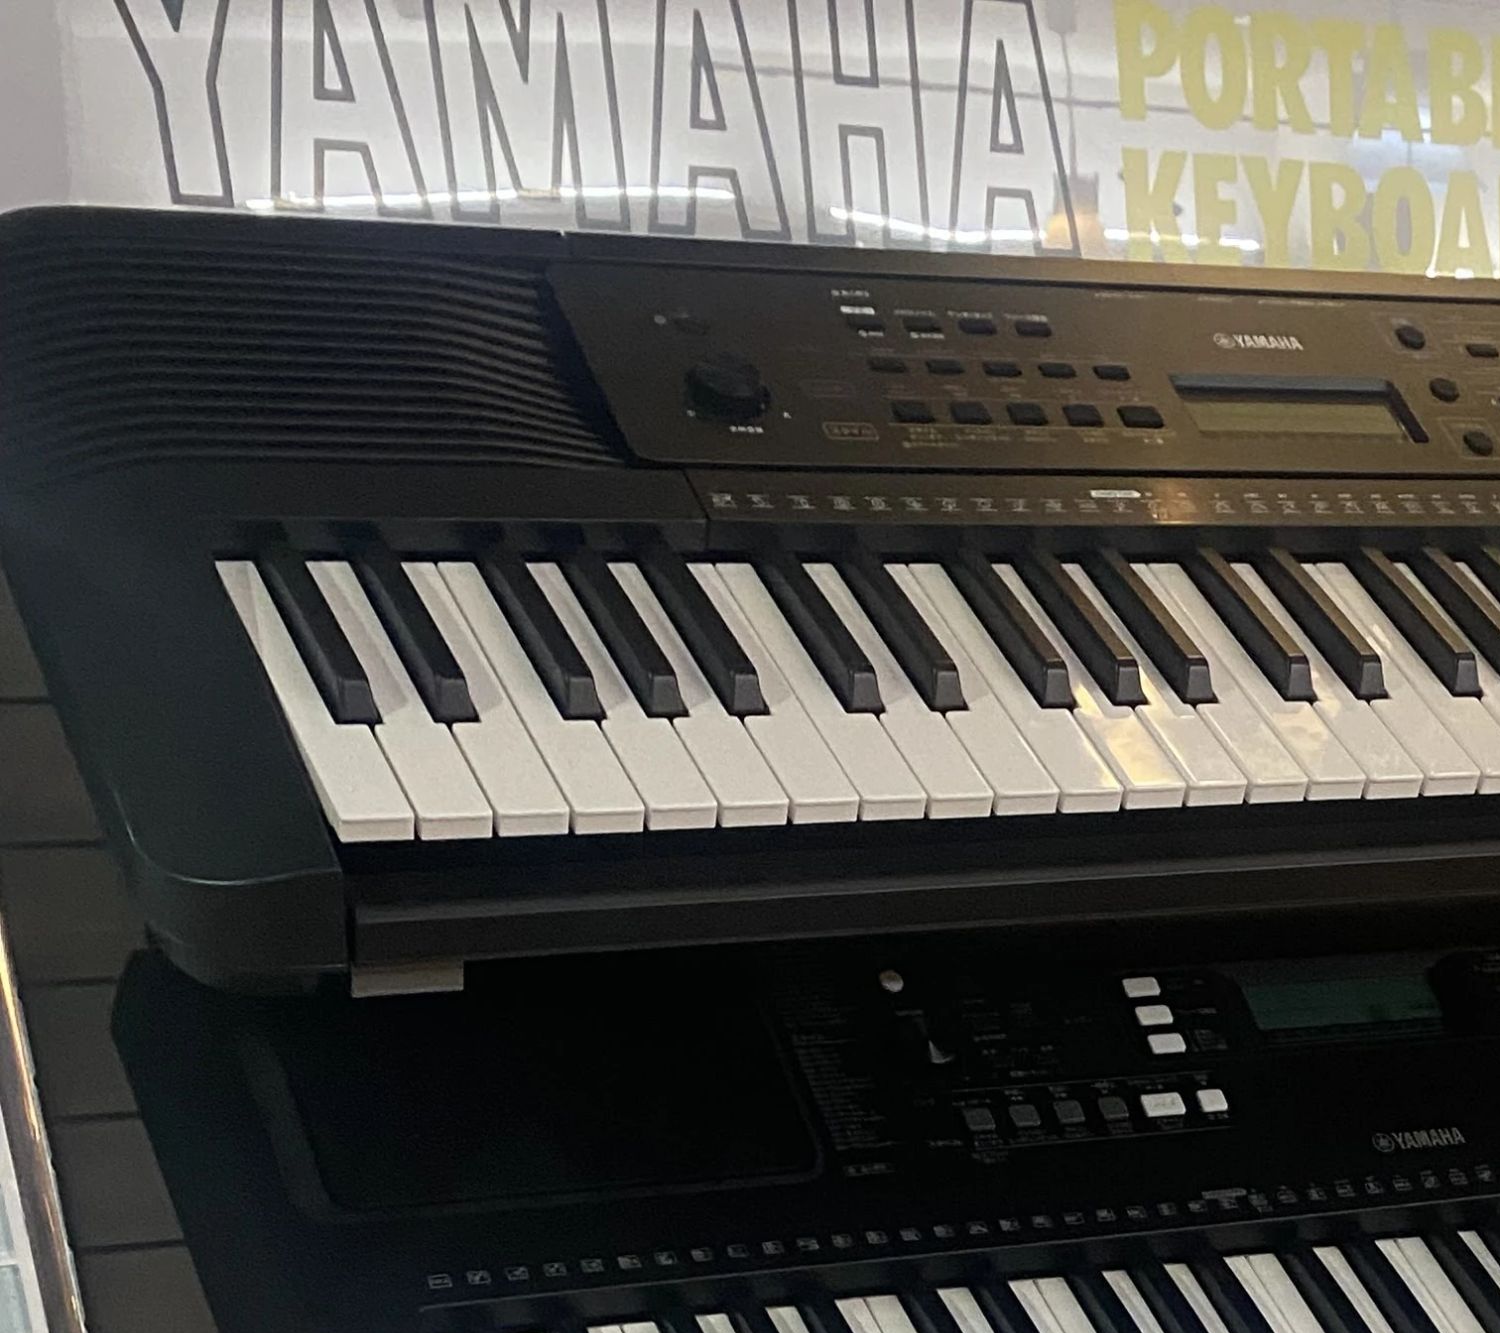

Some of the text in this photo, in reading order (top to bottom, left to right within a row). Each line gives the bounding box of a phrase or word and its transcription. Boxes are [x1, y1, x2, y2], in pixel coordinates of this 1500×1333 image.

[114, 0, 1082, 258] YAMAHA
[1233, 333, 1303, 353] YAMAHA
[1395, 1126, 1466, 1150] YAMAHA
